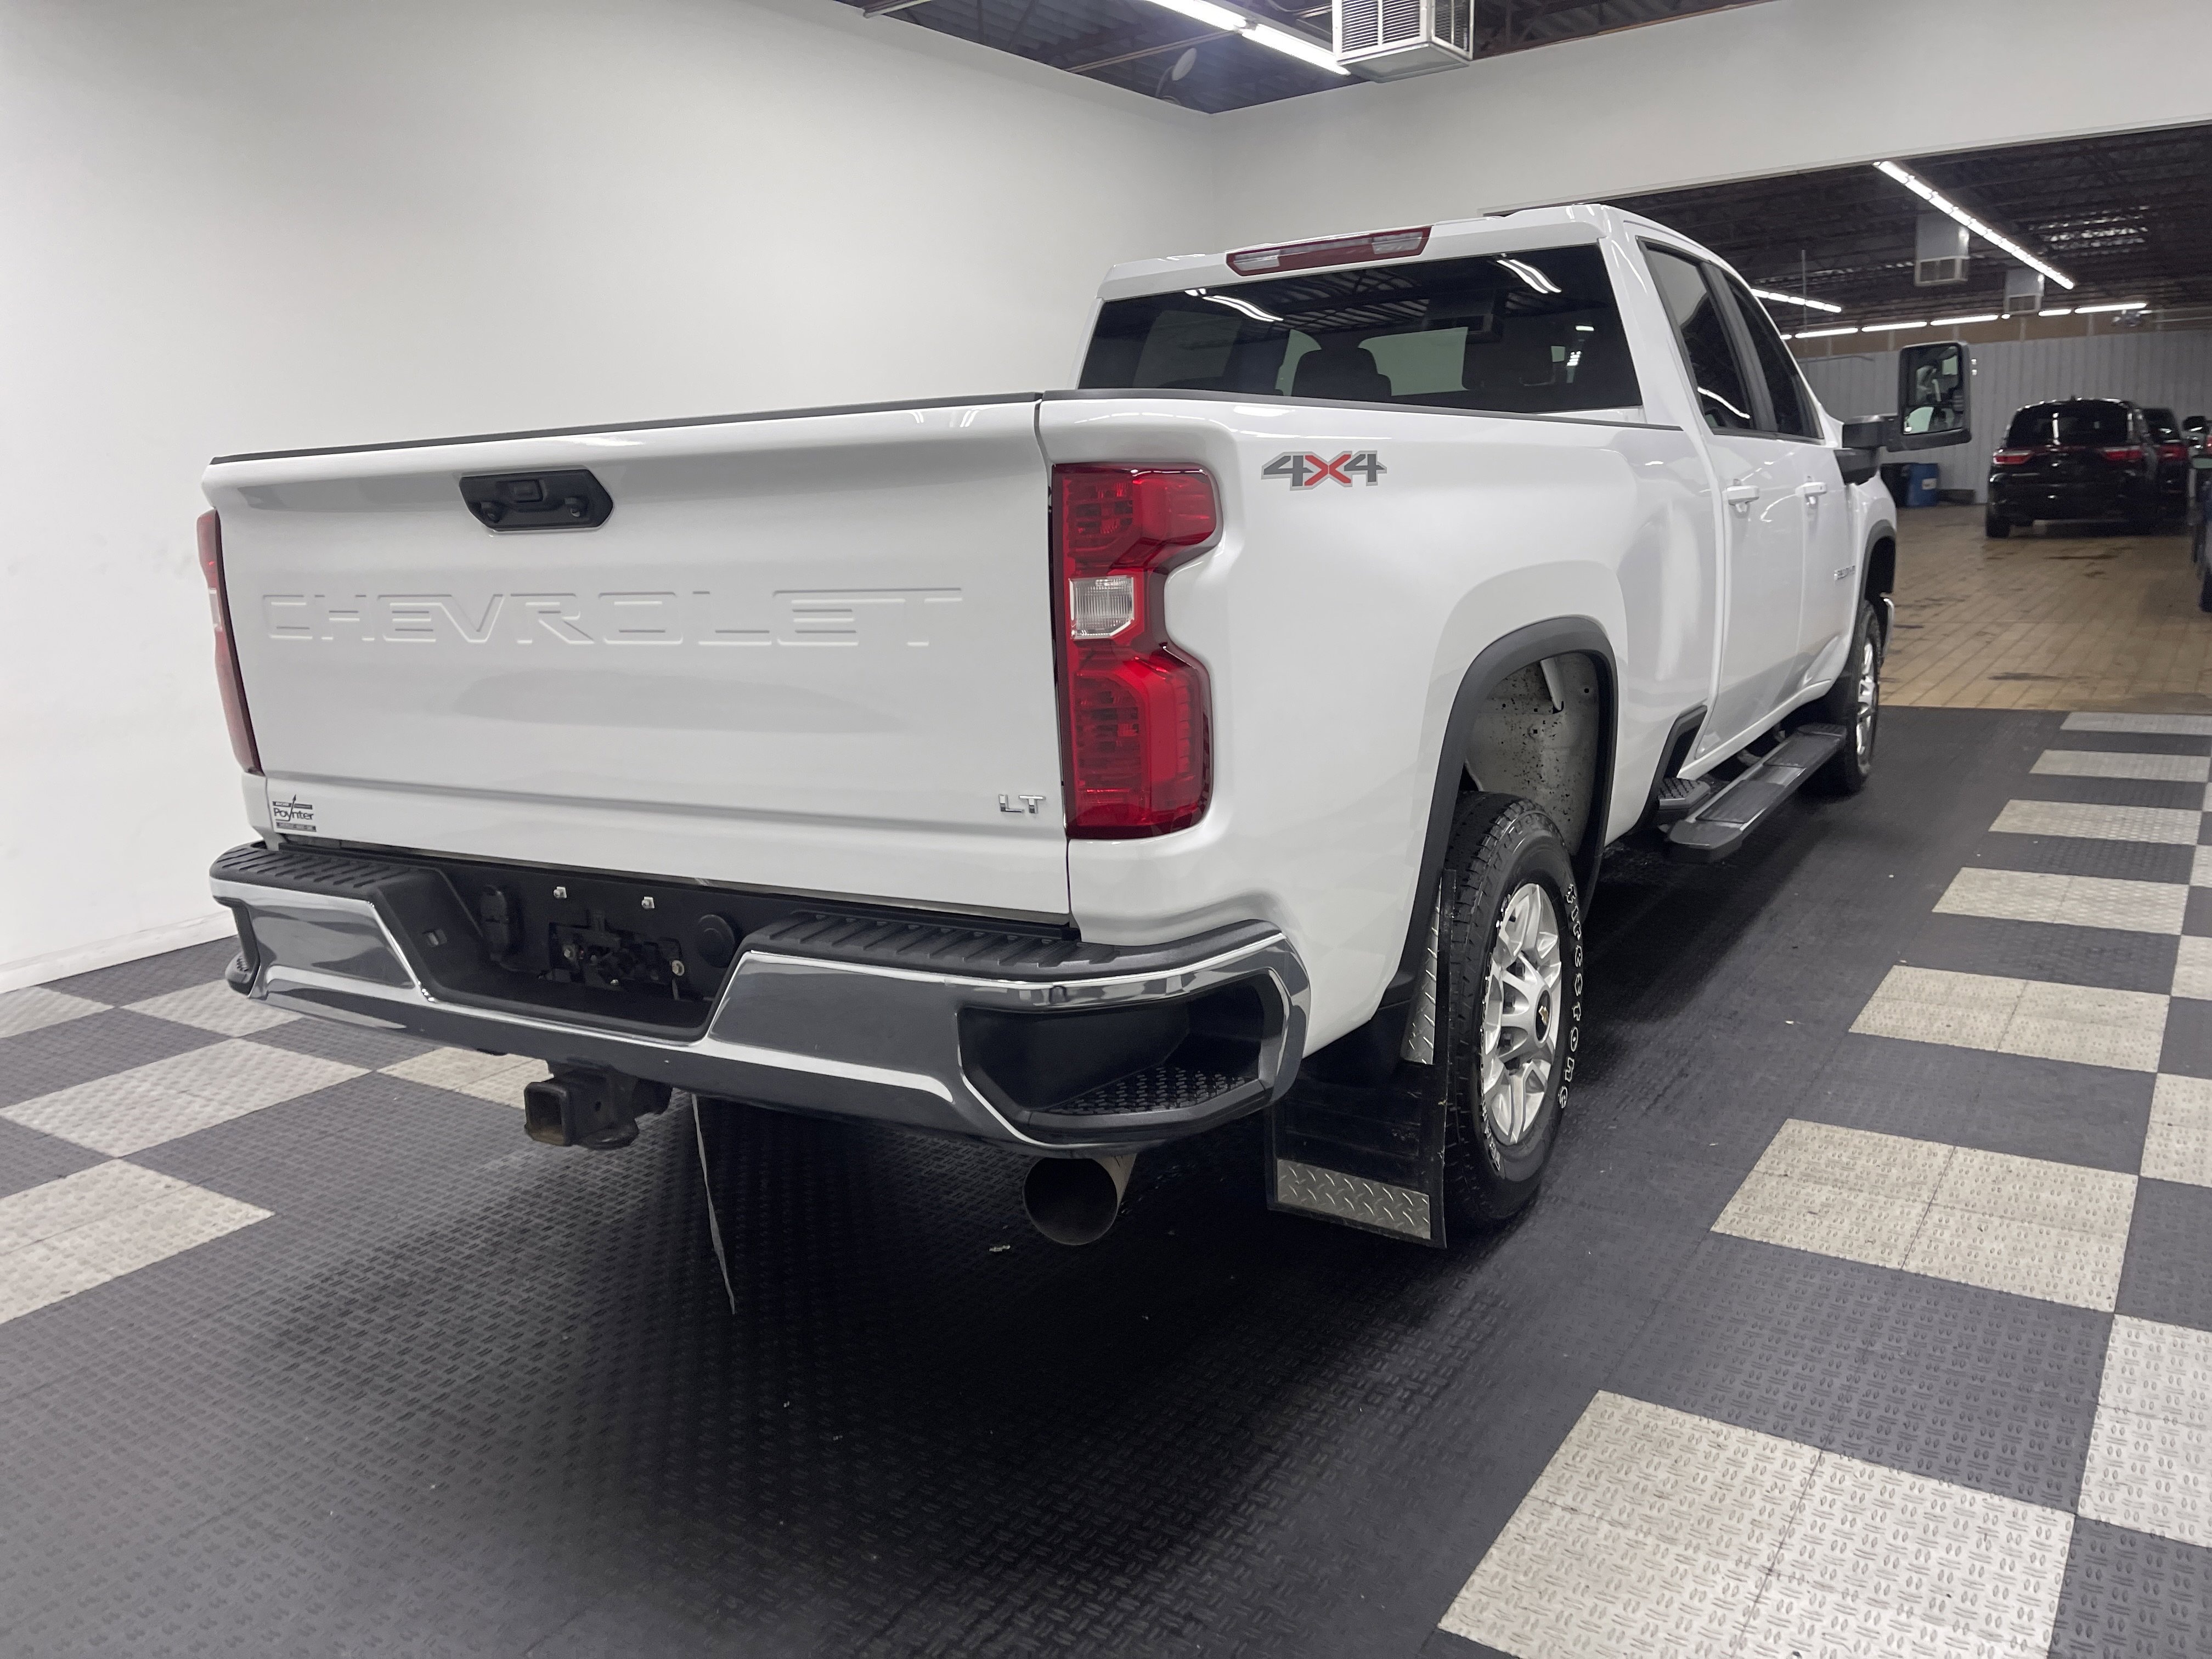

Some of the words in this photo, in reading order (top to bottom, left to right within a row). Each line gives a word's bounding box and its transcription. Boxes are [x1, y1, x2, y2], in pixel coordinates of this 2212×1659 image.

[1262, 450, 1387, 490] 4X4
[262, 587, 963, 645] CHEVROLET
[273, 807, 314, 822] Poynter
[998, 794, 1046, 813] LT
